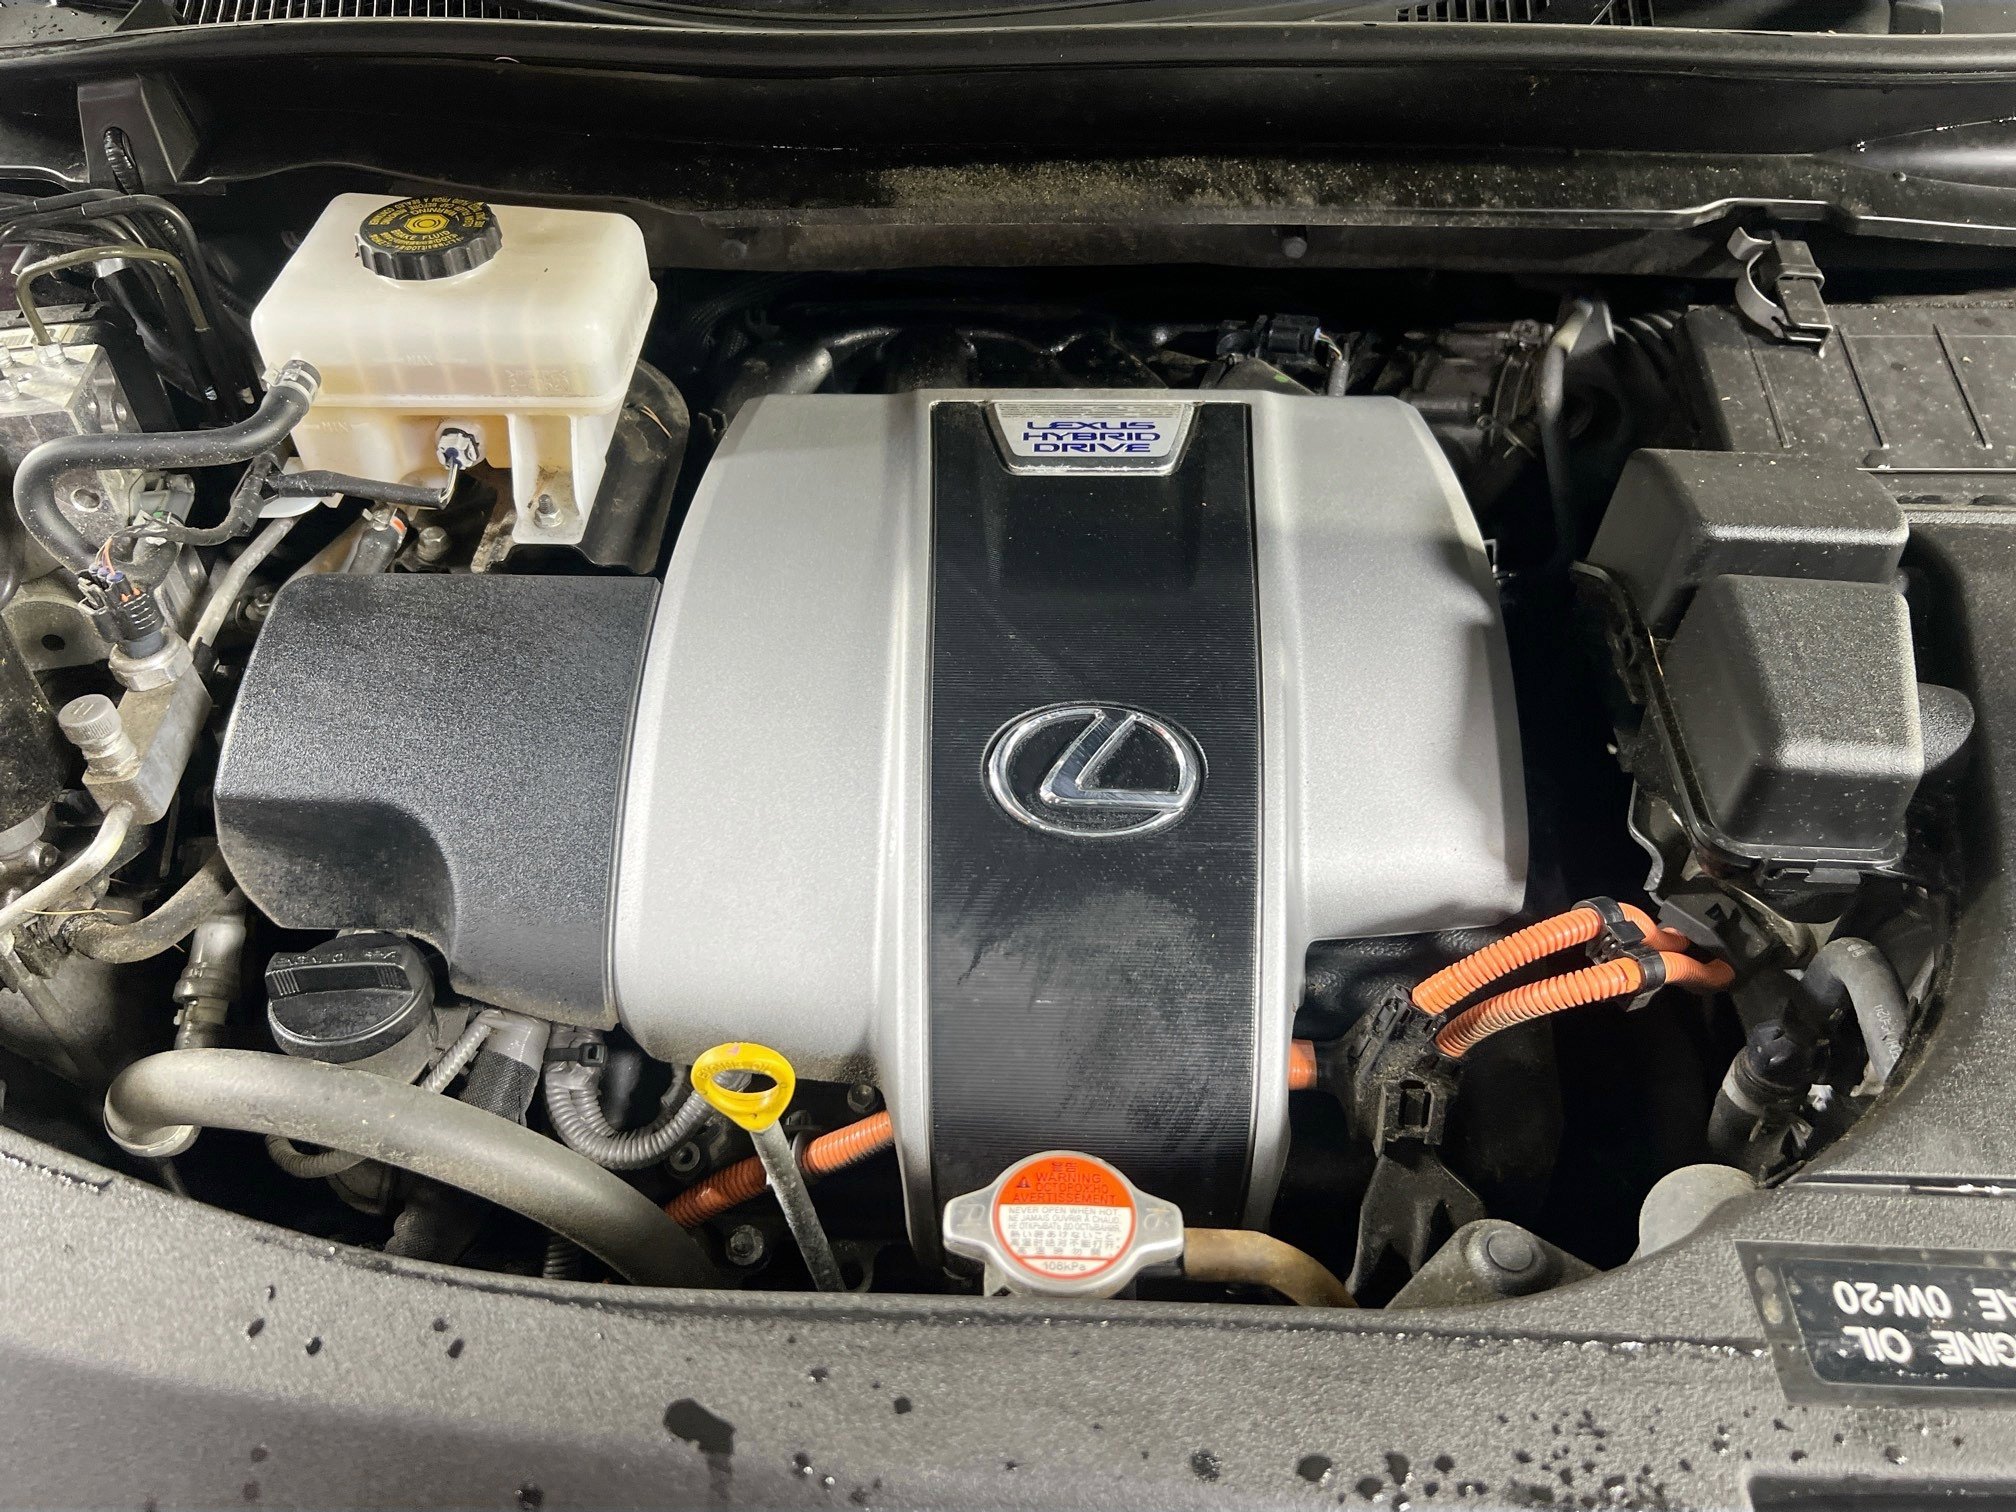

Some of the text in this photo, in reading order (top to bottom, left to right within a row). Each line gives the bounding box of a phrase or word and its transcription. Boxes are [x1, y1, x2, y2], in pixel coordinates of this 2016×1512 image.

[422, 230, 451, 240] FLUID
[1027, 421, 1156, 430] LEXUS
[1023, 432, 1161, 442] HYBRID
[1033, 443, 1151, 453] DRIVE
[1035, 1172, 1102, 1183] WARNING
[1013, 1192, 1117, 1204] AVERTISSEMENT
[1008, 1206, 1039, 1214] NEVER
[1022, 1214, 1050, 1222] JAMAIS
[1832, 1280, 1953, 1319] 0W-20
[1842, 1326, 1912, 1364] OIL
